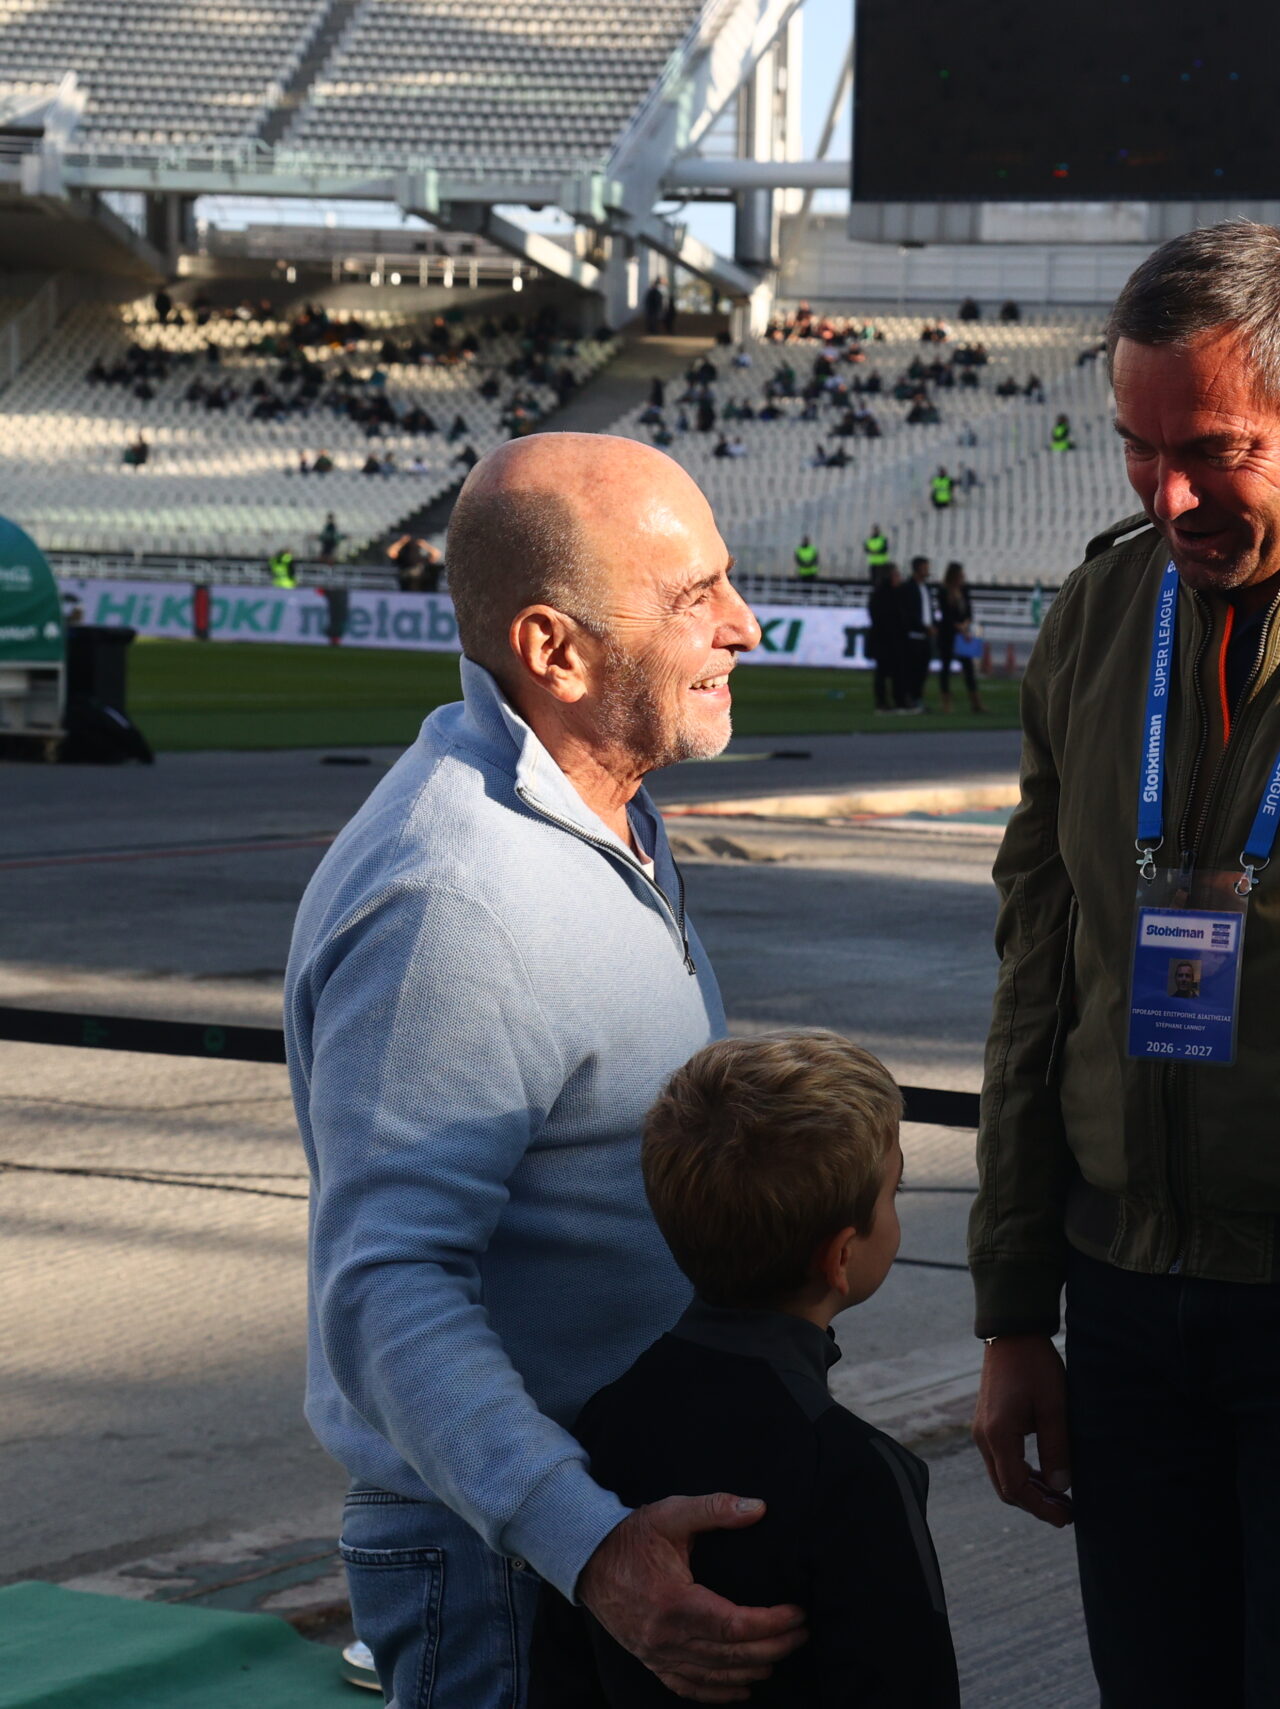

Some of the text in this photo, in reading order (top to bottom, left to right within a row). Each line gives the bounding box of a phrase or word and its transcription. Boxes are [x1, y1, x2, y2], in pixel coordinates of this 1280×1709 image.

[299, 598, 458, 642] metab
[1143, 588, 1174, 803] Stoiximan SUPER LEAGUE
[1146, 924, 1204, 939] Stoiximan
[1146, 1041, 1174, 1054] 2026
[1184, 1044, 1213, 1057] 2027
